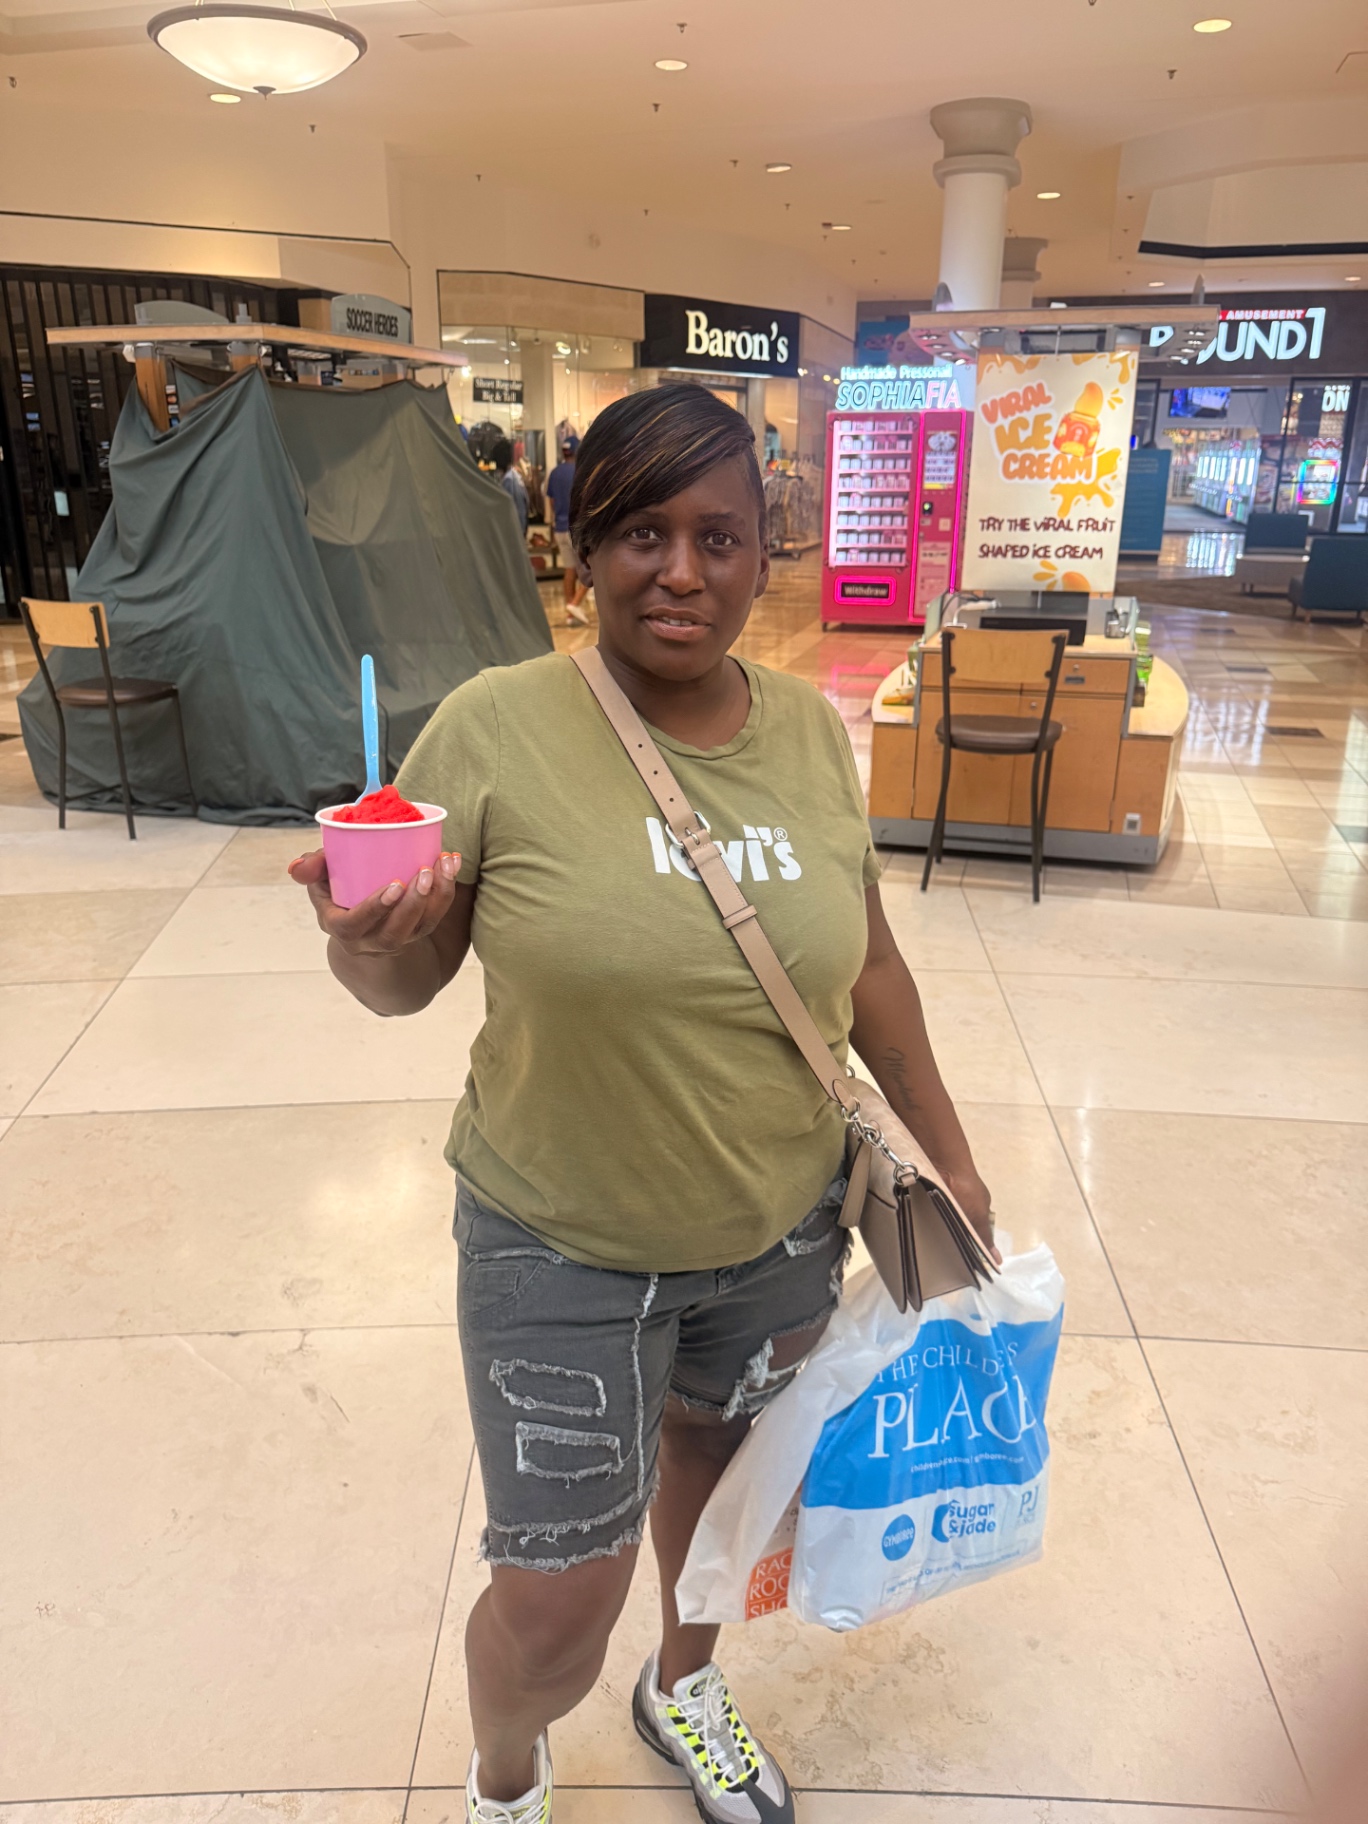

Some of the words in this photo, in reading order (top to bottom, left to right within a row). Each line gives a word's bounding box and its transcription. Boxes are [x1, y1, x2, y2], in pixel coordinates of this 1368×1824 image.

[346, 308, 374, 333] SOCCER
[374, 312, 399, 338] HEROES
[1226, 309, 1306, 320] AMUSEMENT
[685, 309, 789, 363] Baron's
[835, 379, 962, 410] SOPHIAFIA
[981, 382, 1054, 425] VIRAL
[994, 413, 1054, 454] ICE
[1001, 453, 1093, 481] CREAM
[978, 516, 1004, 532] TRY
[1007, 517, 1031, 531] THE
[978, 543, 1029, 559] SHAPED
[1054, 545, 1103, 559] CREAM
